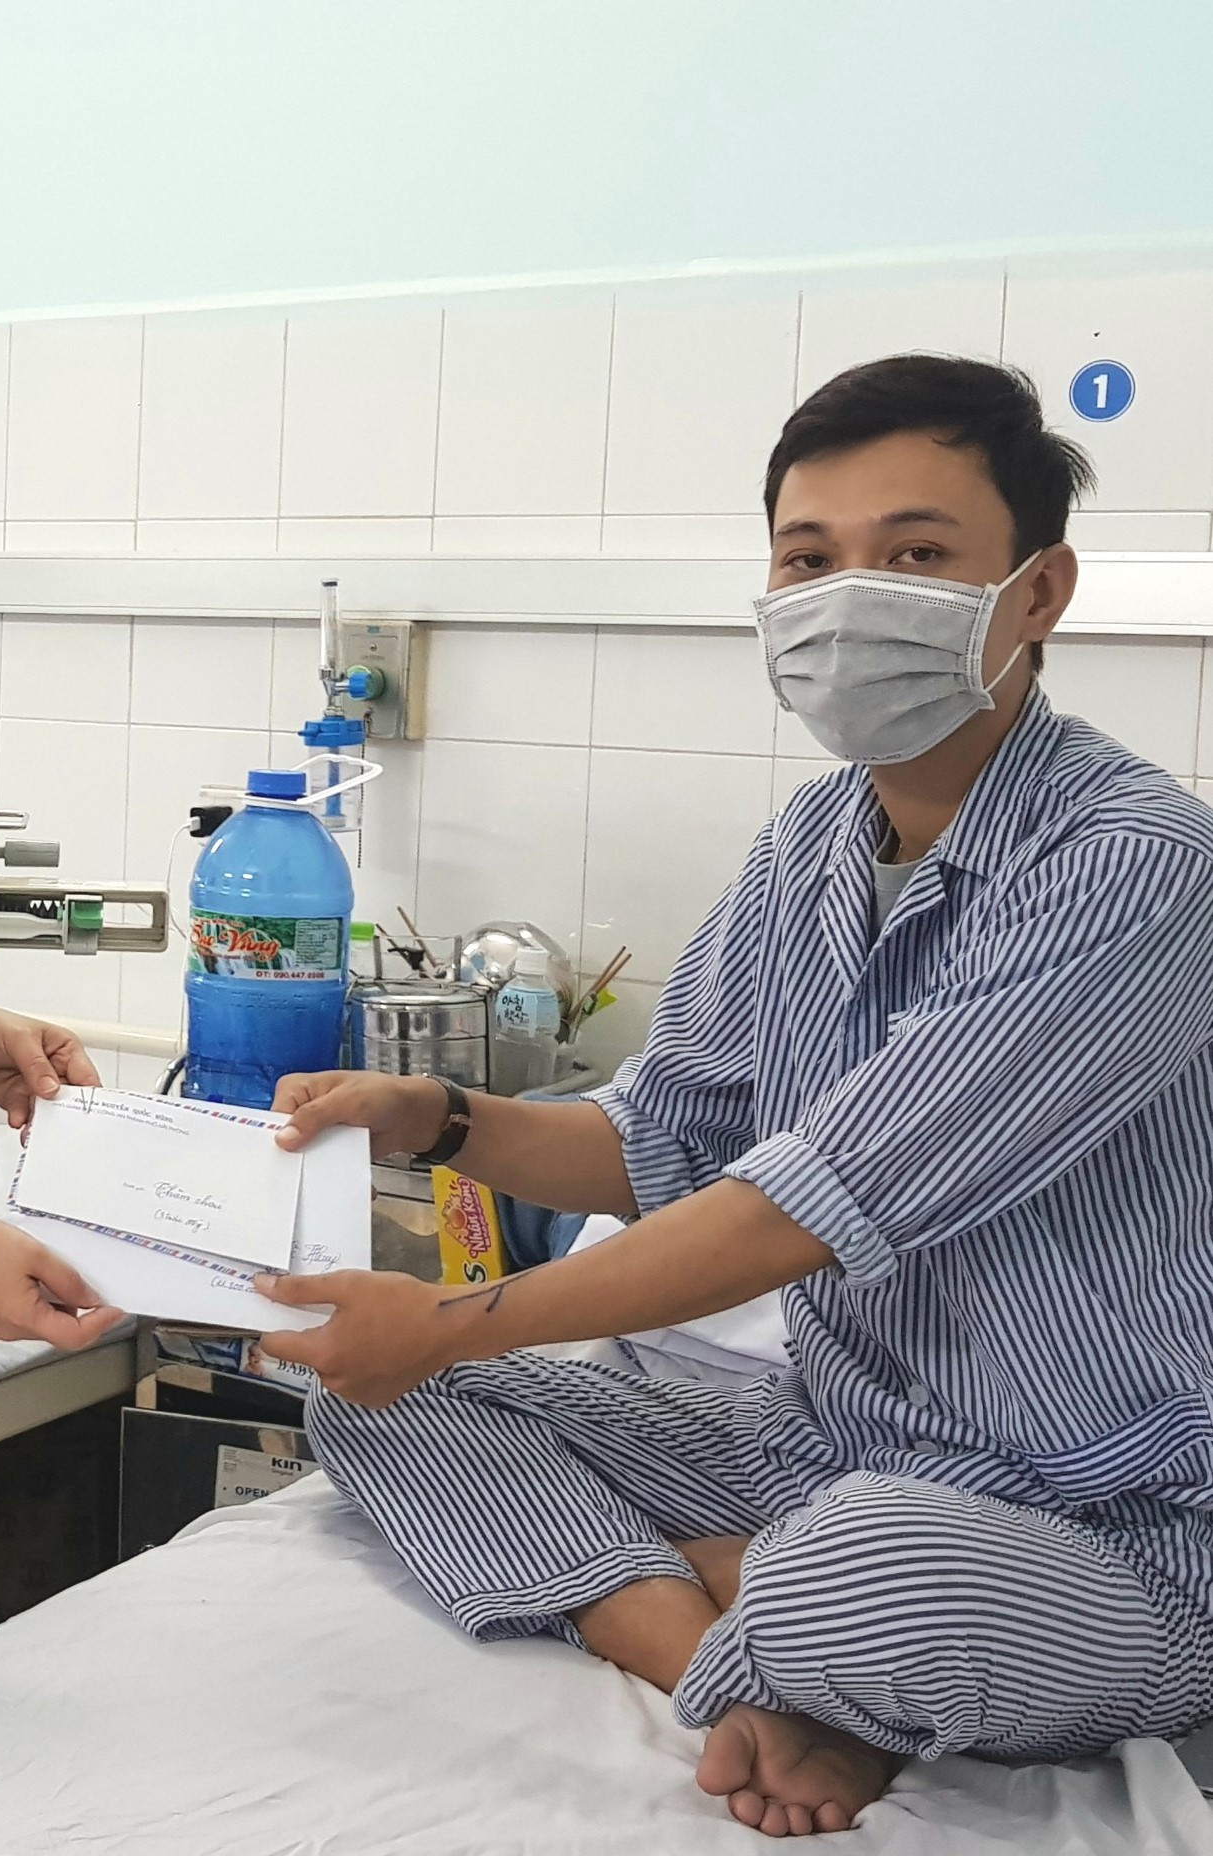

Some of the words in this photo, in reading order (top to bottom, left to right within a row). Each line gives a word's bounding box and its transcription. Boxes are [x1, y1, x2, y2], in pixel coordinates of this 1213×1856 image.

[1093, 374, 1108, 408] 1
[276, 1359, 315, 1380] BABY
[235, 1485, 269, 1498] OPEN
